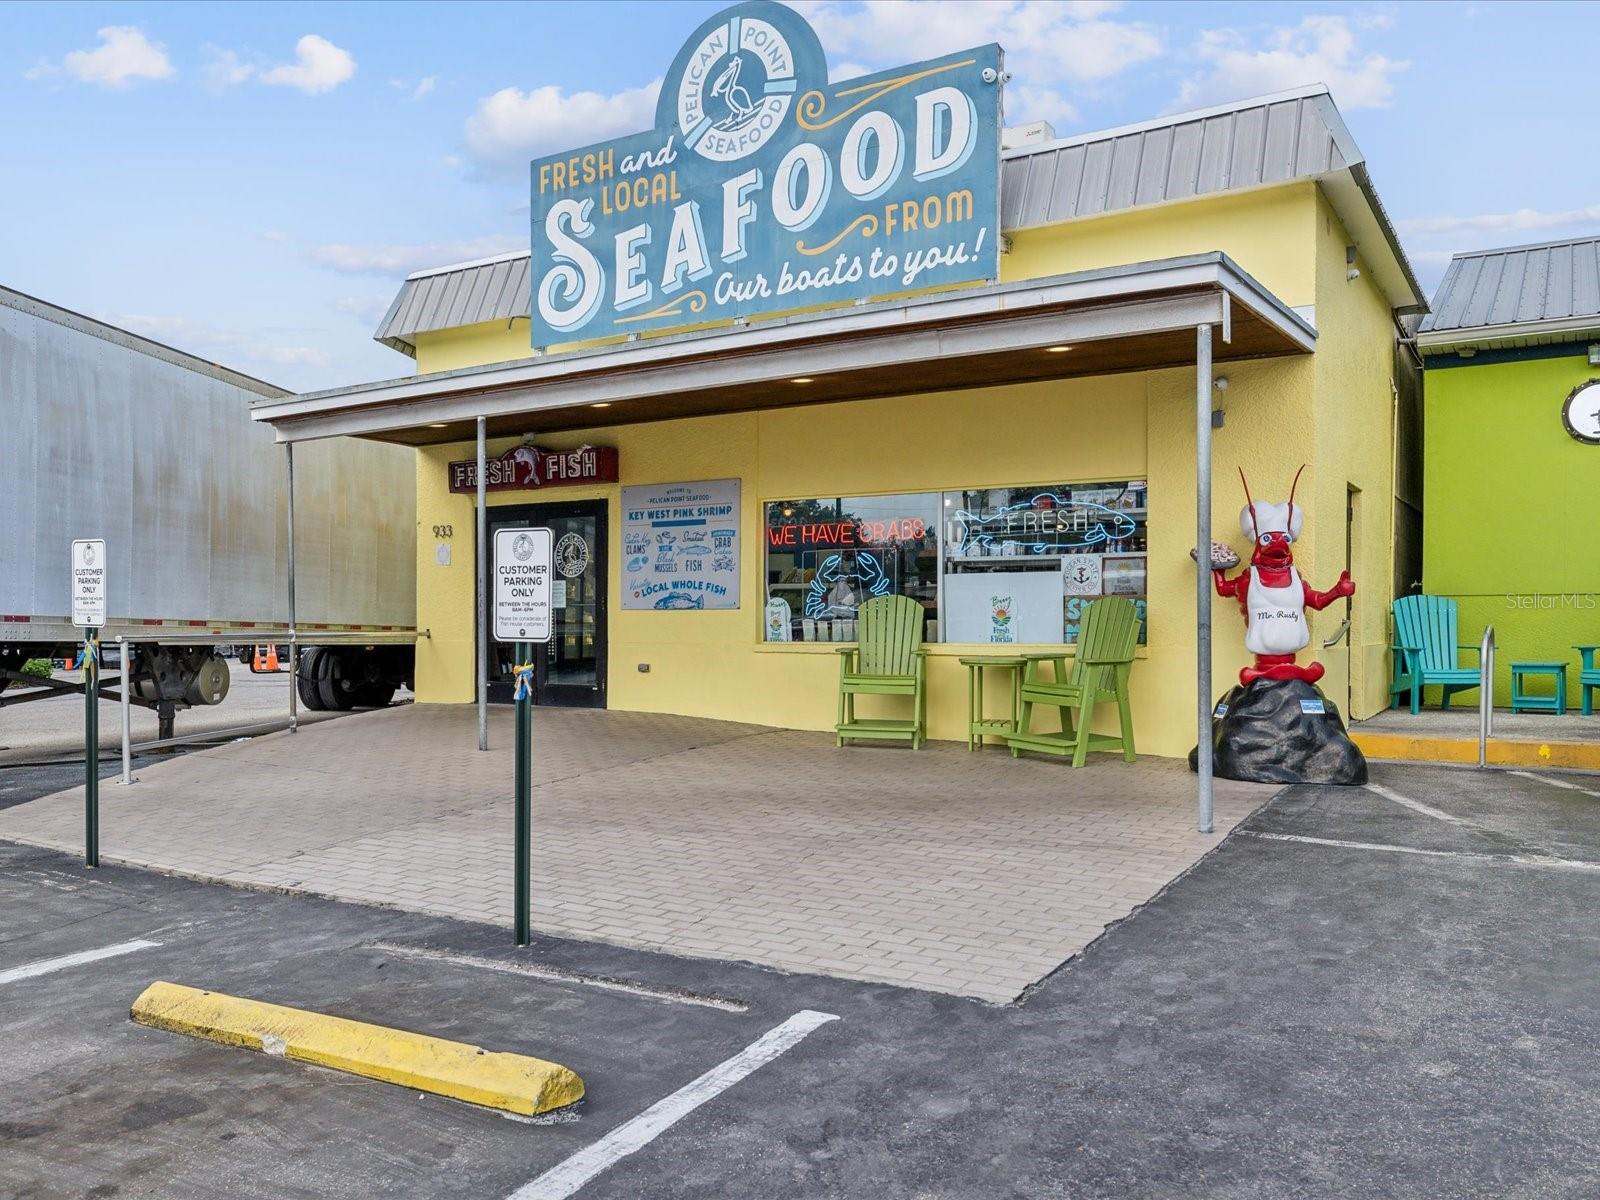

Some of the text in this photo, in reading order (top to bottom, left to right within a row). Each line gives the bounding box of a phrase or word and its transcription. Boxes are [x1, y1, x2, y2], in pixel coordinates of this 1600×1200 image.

[685, 27, 787, 125] PELICAN POINT
[705, 99, 783, 154] SEAFOOD
[539, 135, 678, 194] FRESH and
[602, 170, 682, 215] LOCAL
[537, 86, 978, 332] SEAFOOD
[885, 189, 973, 236] FROM
[714, 227, 987, 305] Our boats to you!
[546, 452, 597, 480] FISH
[628, 506, 732, 520] KEY WEST PINK SHRIMP
[1007, 509, 1089, 534] FRESH
[432, 524, 453, 538] 933
[769, 518, 926, 545] WE HAVE CRABS
[714, 537, 732, 548] CRAB
[626, 545, 646, 555] CLAMS
[499, 565, 547, 574] CUSTOMER
[654, 563, 678, 572] MUSSELS
[685, 559, 702, 571] FISH
[75, 568, 103, 576] CUSTOMER
[78, 577, 100, 585] PARKING
[504, 577, 543, 586] PARKING
[82, 586, 96, 594] ONLY
[511, 588, 535, 597] ONLY
[641, 582, 669, 597] LOCAL
[672, 580, 703, 590] WHOLE
[706, 582, 727, 596] FISH
[1257, 610, 1299, 623] Mr. Rusty
[993, 626, 1010, 634] Fresh
[990, 635, 1012, 643] Florida
